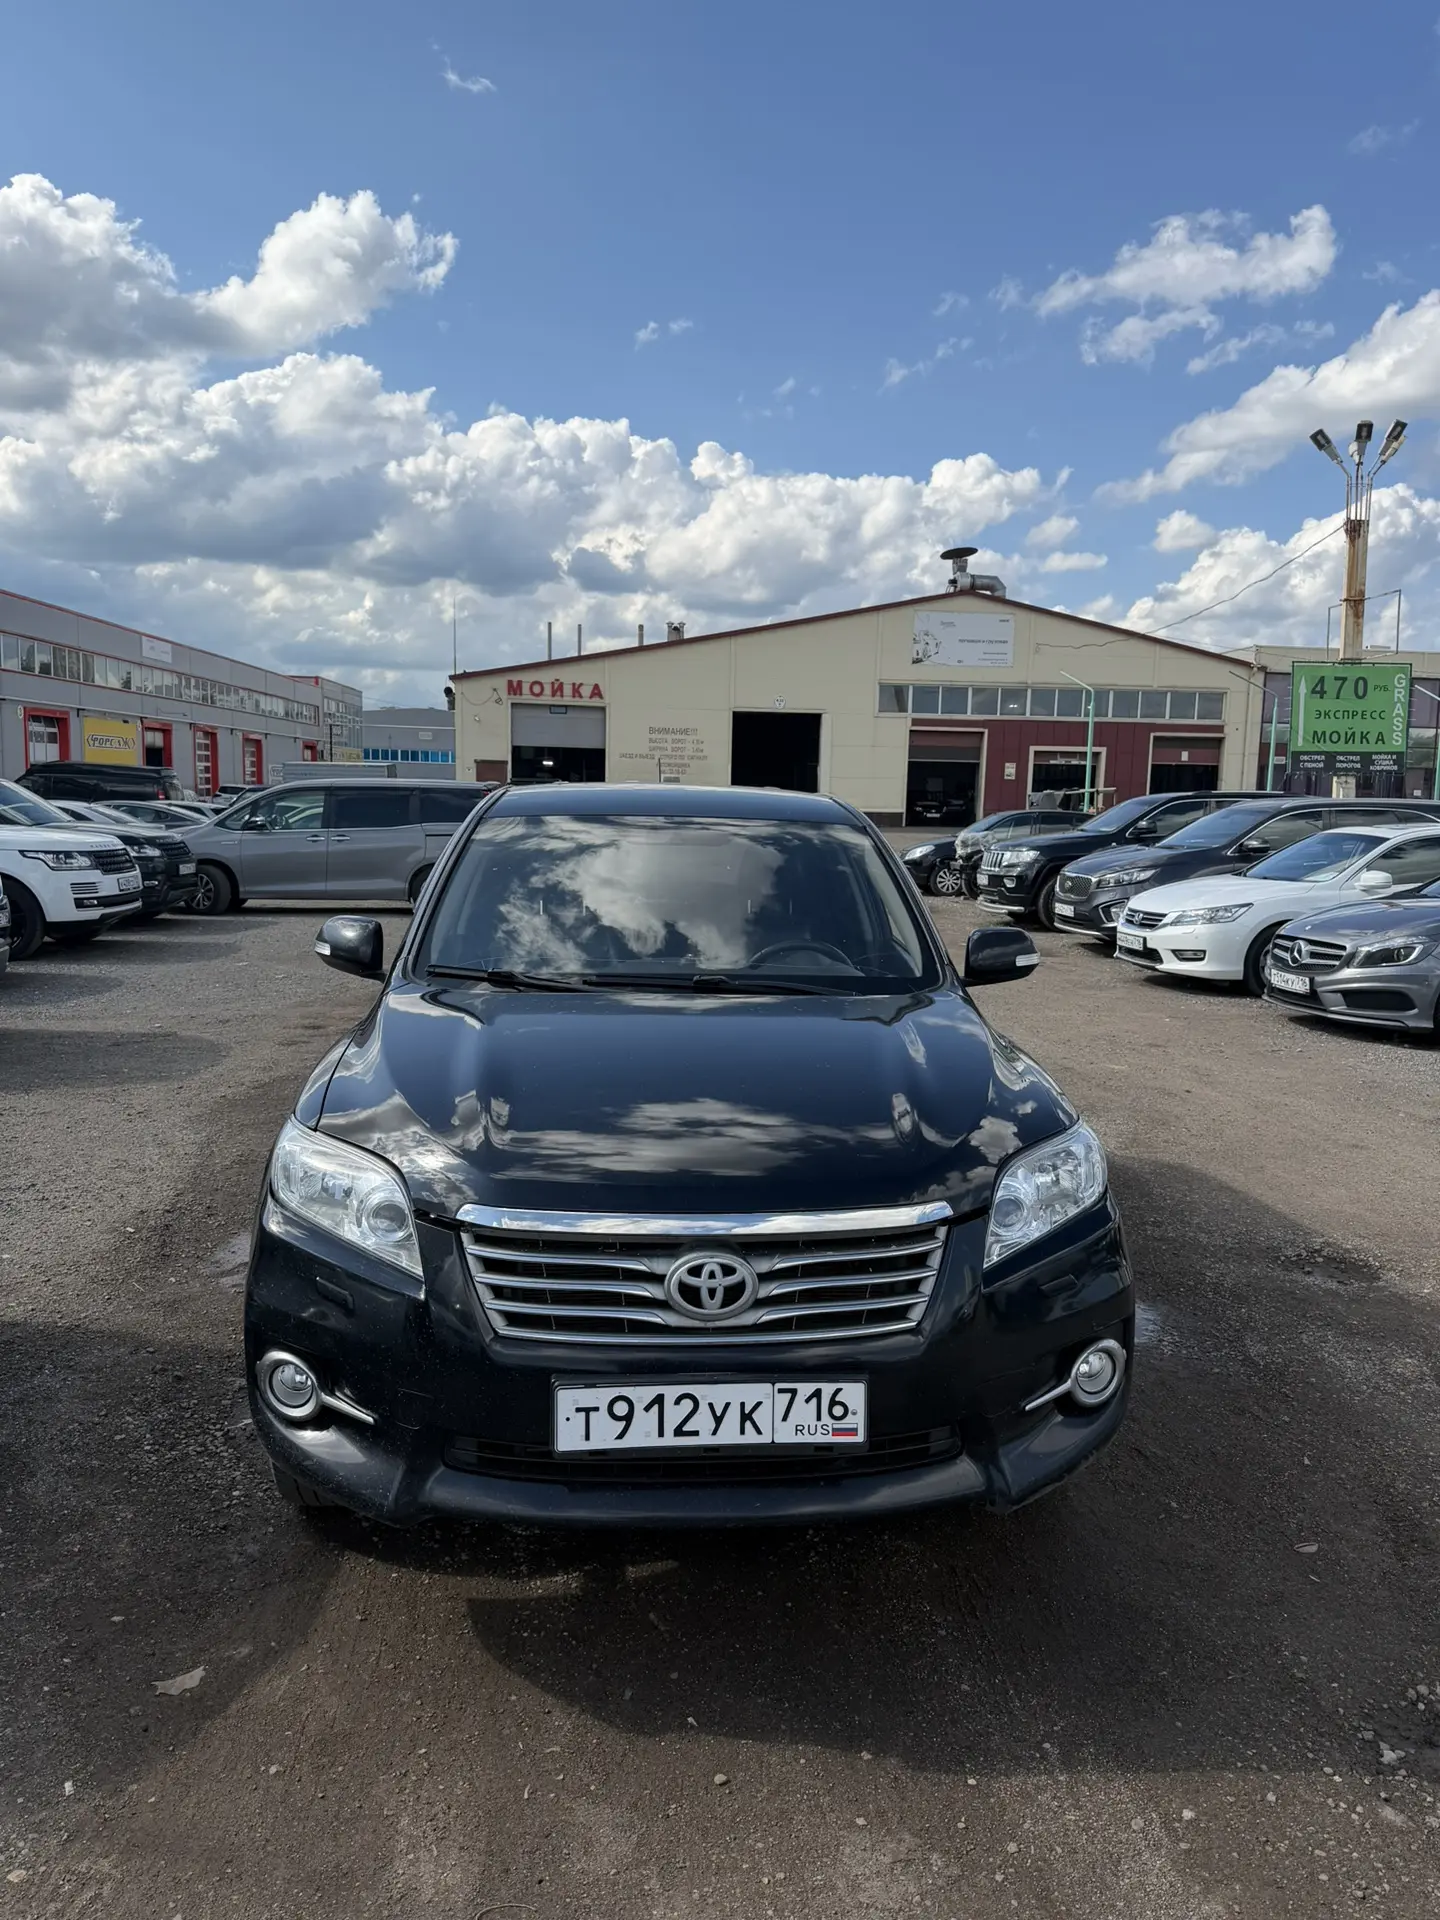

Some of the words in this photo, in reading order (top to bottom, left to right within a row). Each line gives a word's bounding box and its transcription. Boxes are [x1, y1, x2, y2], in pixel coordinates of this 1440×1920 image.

[507, 678, 604, 700] МОЙКА
[1311, 675, 1369, 700] 470
[1373, 684, 1391, 692] РУБ.
[1314, 709, 1386, 720] ЭКСПРЕСС
[1392, 673, 1406, 746] GRASS
[1312, 727, 1386, 745] МОЙКА
[575, 1392, 764, 1441] Т912УК
[777, 1387, 849, 1422] 716
[794, 1423, 830, 1437] RUS
